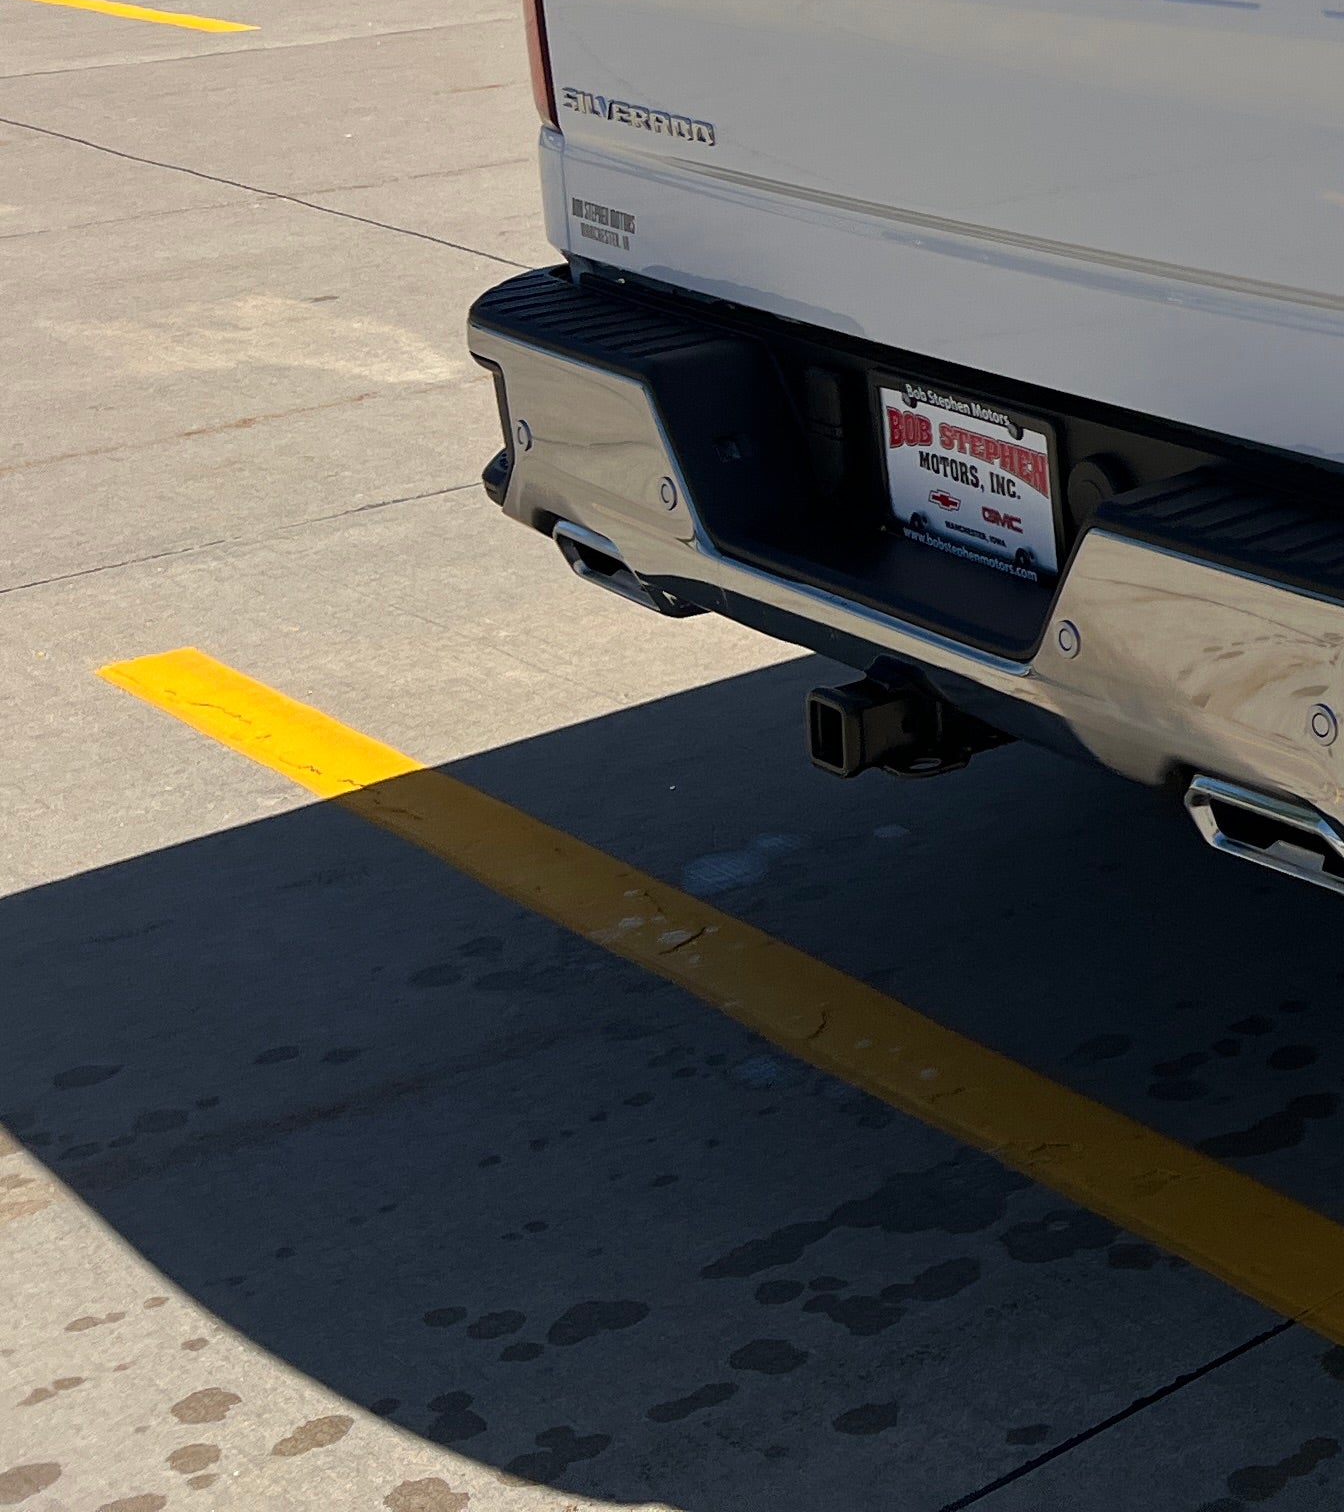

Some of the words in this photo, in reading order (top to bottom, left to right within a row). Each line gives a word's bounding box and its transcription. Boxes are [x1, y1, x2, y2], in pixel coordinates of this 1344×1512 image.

[562, 86, 716, 147] SILVERADO
[906, 383, 927, 402] Bob
[929, 391, 970, 417] Stephen
[971, 402, 1010, 426] Motors
[886, 406, 933, 449] BOB
[938, 422, 1050, 500] STEPHEN
[918, 450, 986, 493] MOTORS,
[989, 471, 1022, 500] INC.
[981, 505, 1024, 534] GMC
[988, 533, 1007, 548] IOWA
[903, 527, 1038, 582] www.bobstephenmotors.com
